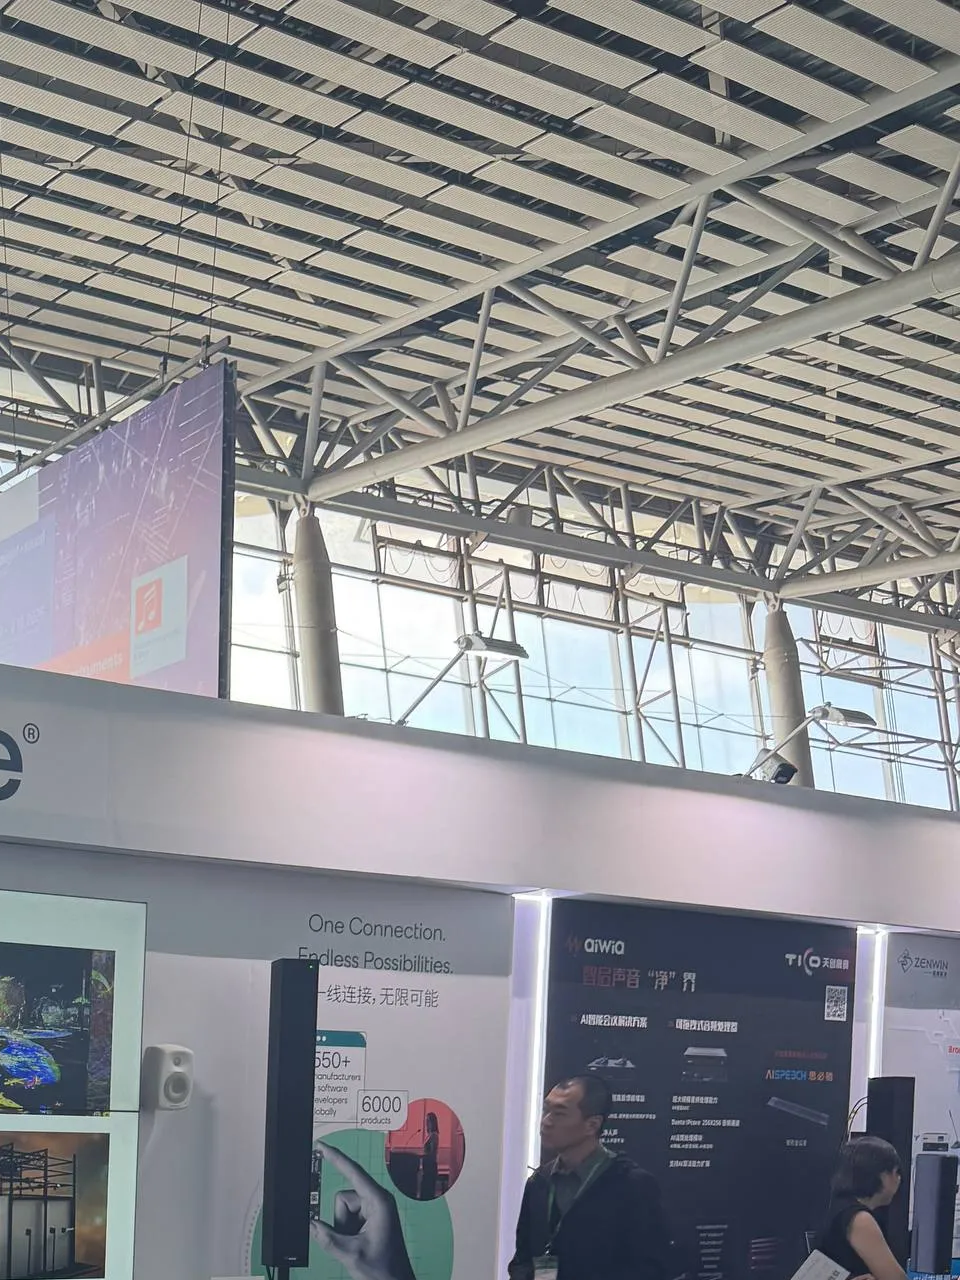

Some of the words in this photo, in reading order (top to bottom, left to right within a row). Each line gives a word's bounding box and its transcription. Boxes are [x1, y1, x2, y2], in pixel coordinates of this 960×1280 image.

[308, 913, 345, 933] One
[349, 917, 447, 942] Connection.
[364, 951, 454, 975] Possibilities.
[914, 957, 949, 971] ZENWIN
[317, 1084, 348, 1093] software
[314, 1096, 348, 1105] evelopers
[362, 1095, 401, 1113] 6000
[360, 1116, 391, 1126] products
